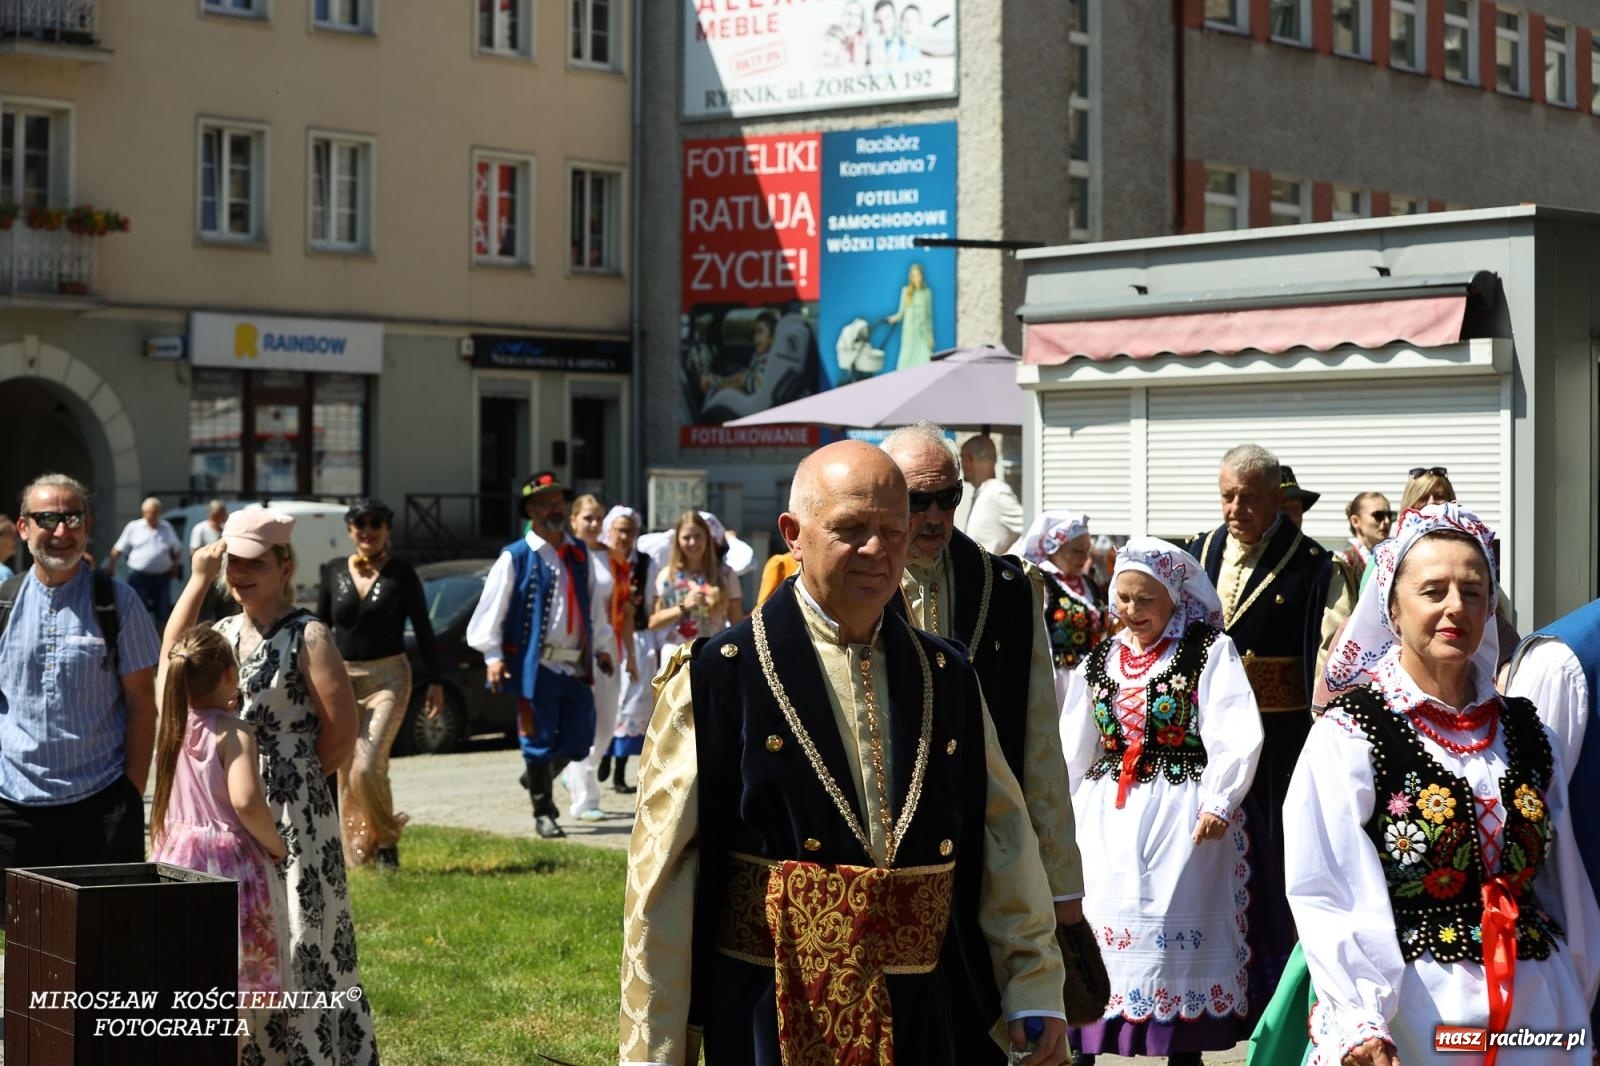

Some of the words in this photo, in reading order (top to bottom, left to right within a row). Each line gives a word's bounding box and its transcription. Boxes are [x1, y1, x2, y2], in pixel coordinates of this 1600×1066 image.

[695, 12, 779, 41] MEBLE
[904, 69, 932, 90] 192
[855, 134, 921, 154] Racibórz
[686, 140, 819, 178] FOTELIKI
[839, 158, 925, 178] Komunalna
[926, 154, 938, 173] 7
[855, 188, 920, 207] FOTELIKI
[689, 191, 816, 237] RATUJĄ
[827, 210, 948, 231] SAMOCHODOWE
[826, 234, 876, 253] WÓZKI
[690, 243, 809, 291] ŻYCIE!
[263, 332, 347, 356] RAINBOW
[690, 427, 809, 445] FOTELIKOWANIE
